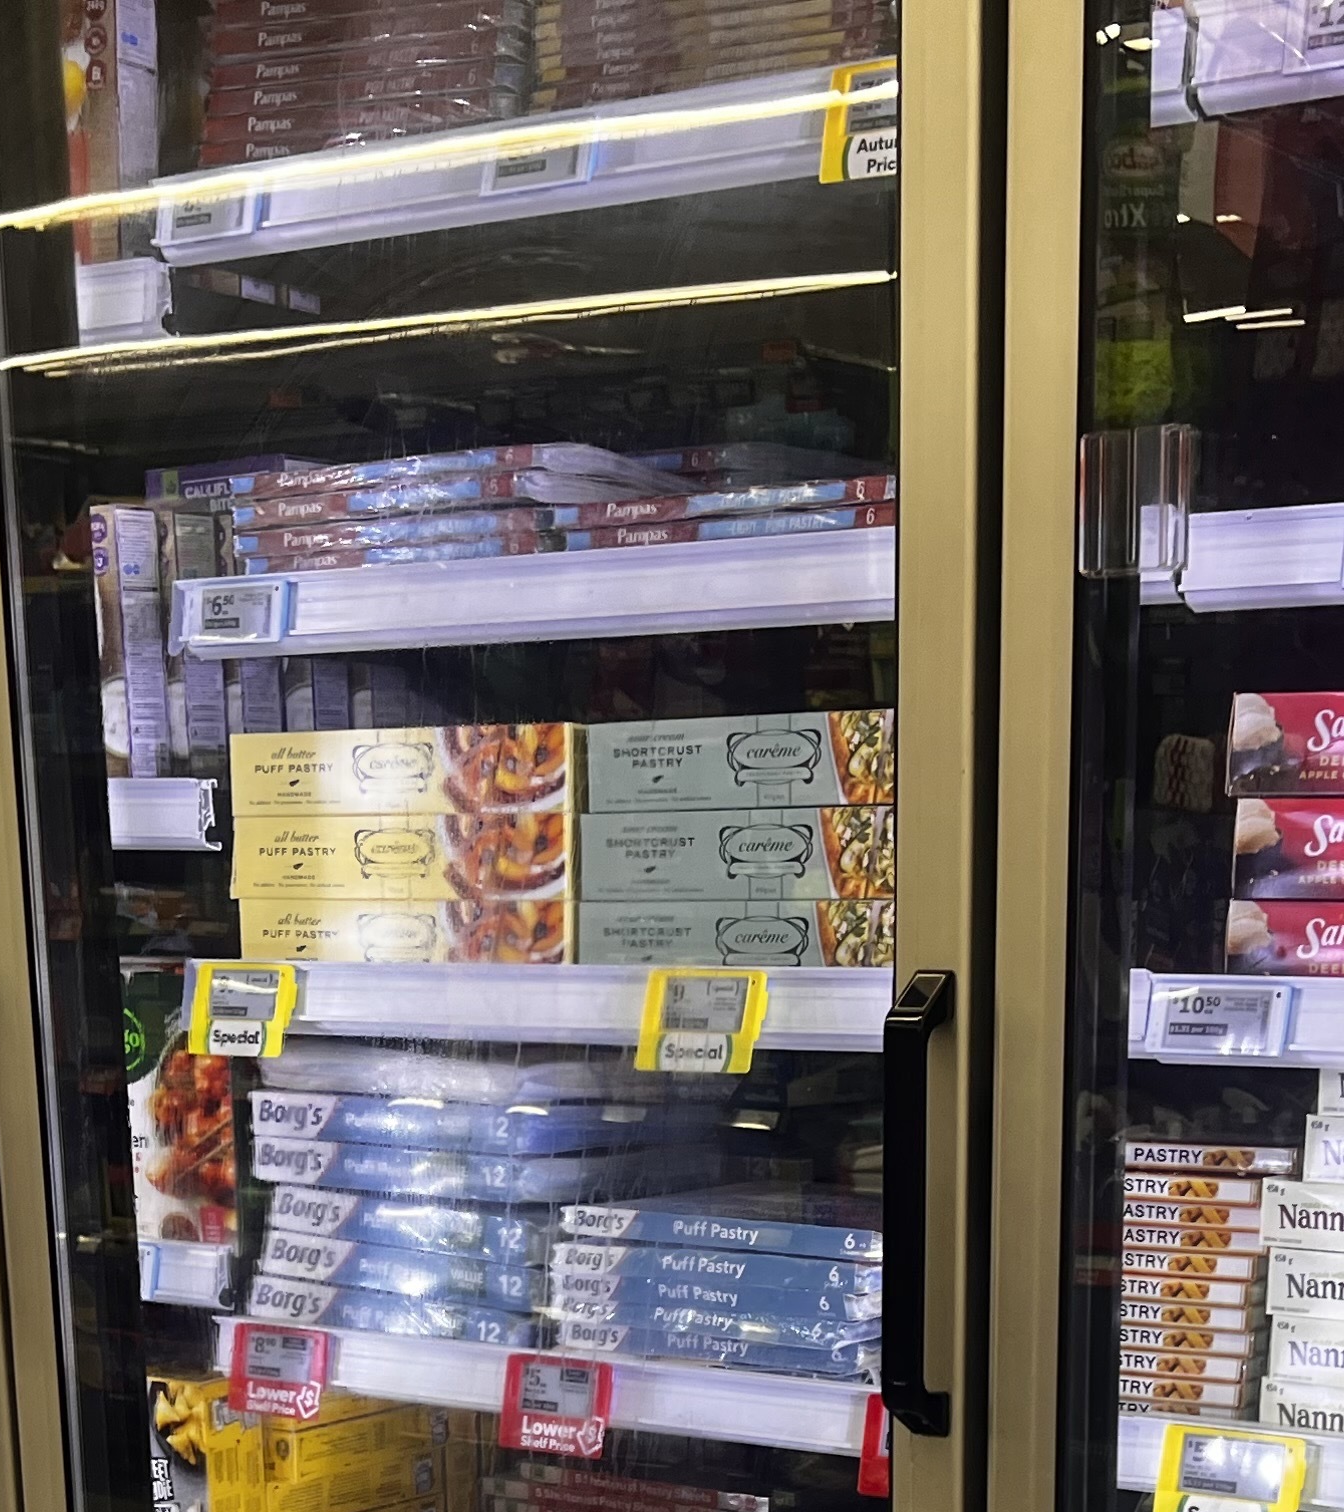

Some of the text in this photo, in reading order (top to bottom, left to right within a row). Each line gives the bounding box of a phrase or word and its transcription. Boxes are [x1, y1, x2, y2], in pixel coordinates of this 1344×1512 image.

[257, 28, 303, 48] Pampas
[256, 59, 301, 81] Pampas
[248, 117, 293, 135] Pampas
[277, 498, 323, 519] Pampas
[605, 500, 657, 519] Pampas
[865, 508, 875, 523] 6
[617, 526, 668, 546] Pampas
[746, 744, 800, 759] carême
[254, 764, 333, 773] PUFF PASTRY
[632, 758, 684, 769] PASTRY
[1299, 770, 1338, 779] APPLE
[258, 847, 336, 856] PUFF PASTRY
[738, 839, 795, 852] carême
[213, 1027, 260, 1046] Special
[664, 1043, 724, 1063] Special
[258, 1100, 322, 1132] Borg's
[486, 1114, 510, 1138] 12
[258, 1145, 322, 1175] Borg's
[1134, 1147, 1202, 1166] PASTRY
[277, 1192, 340, 1225] Borg's
[574, 1209, 626, 1234] Borg's
[496, 1225, 522, 1250] 12
[672, 1220, 855, 1249] Puff Pastry 6
[271, 1238, 336, 1271] Borg's
[661, 1255, 840, 1282] Puff Pastry 6
[247, 1380, 297, 1406] Lower
[521, 1415, 576, 1441] Lower
